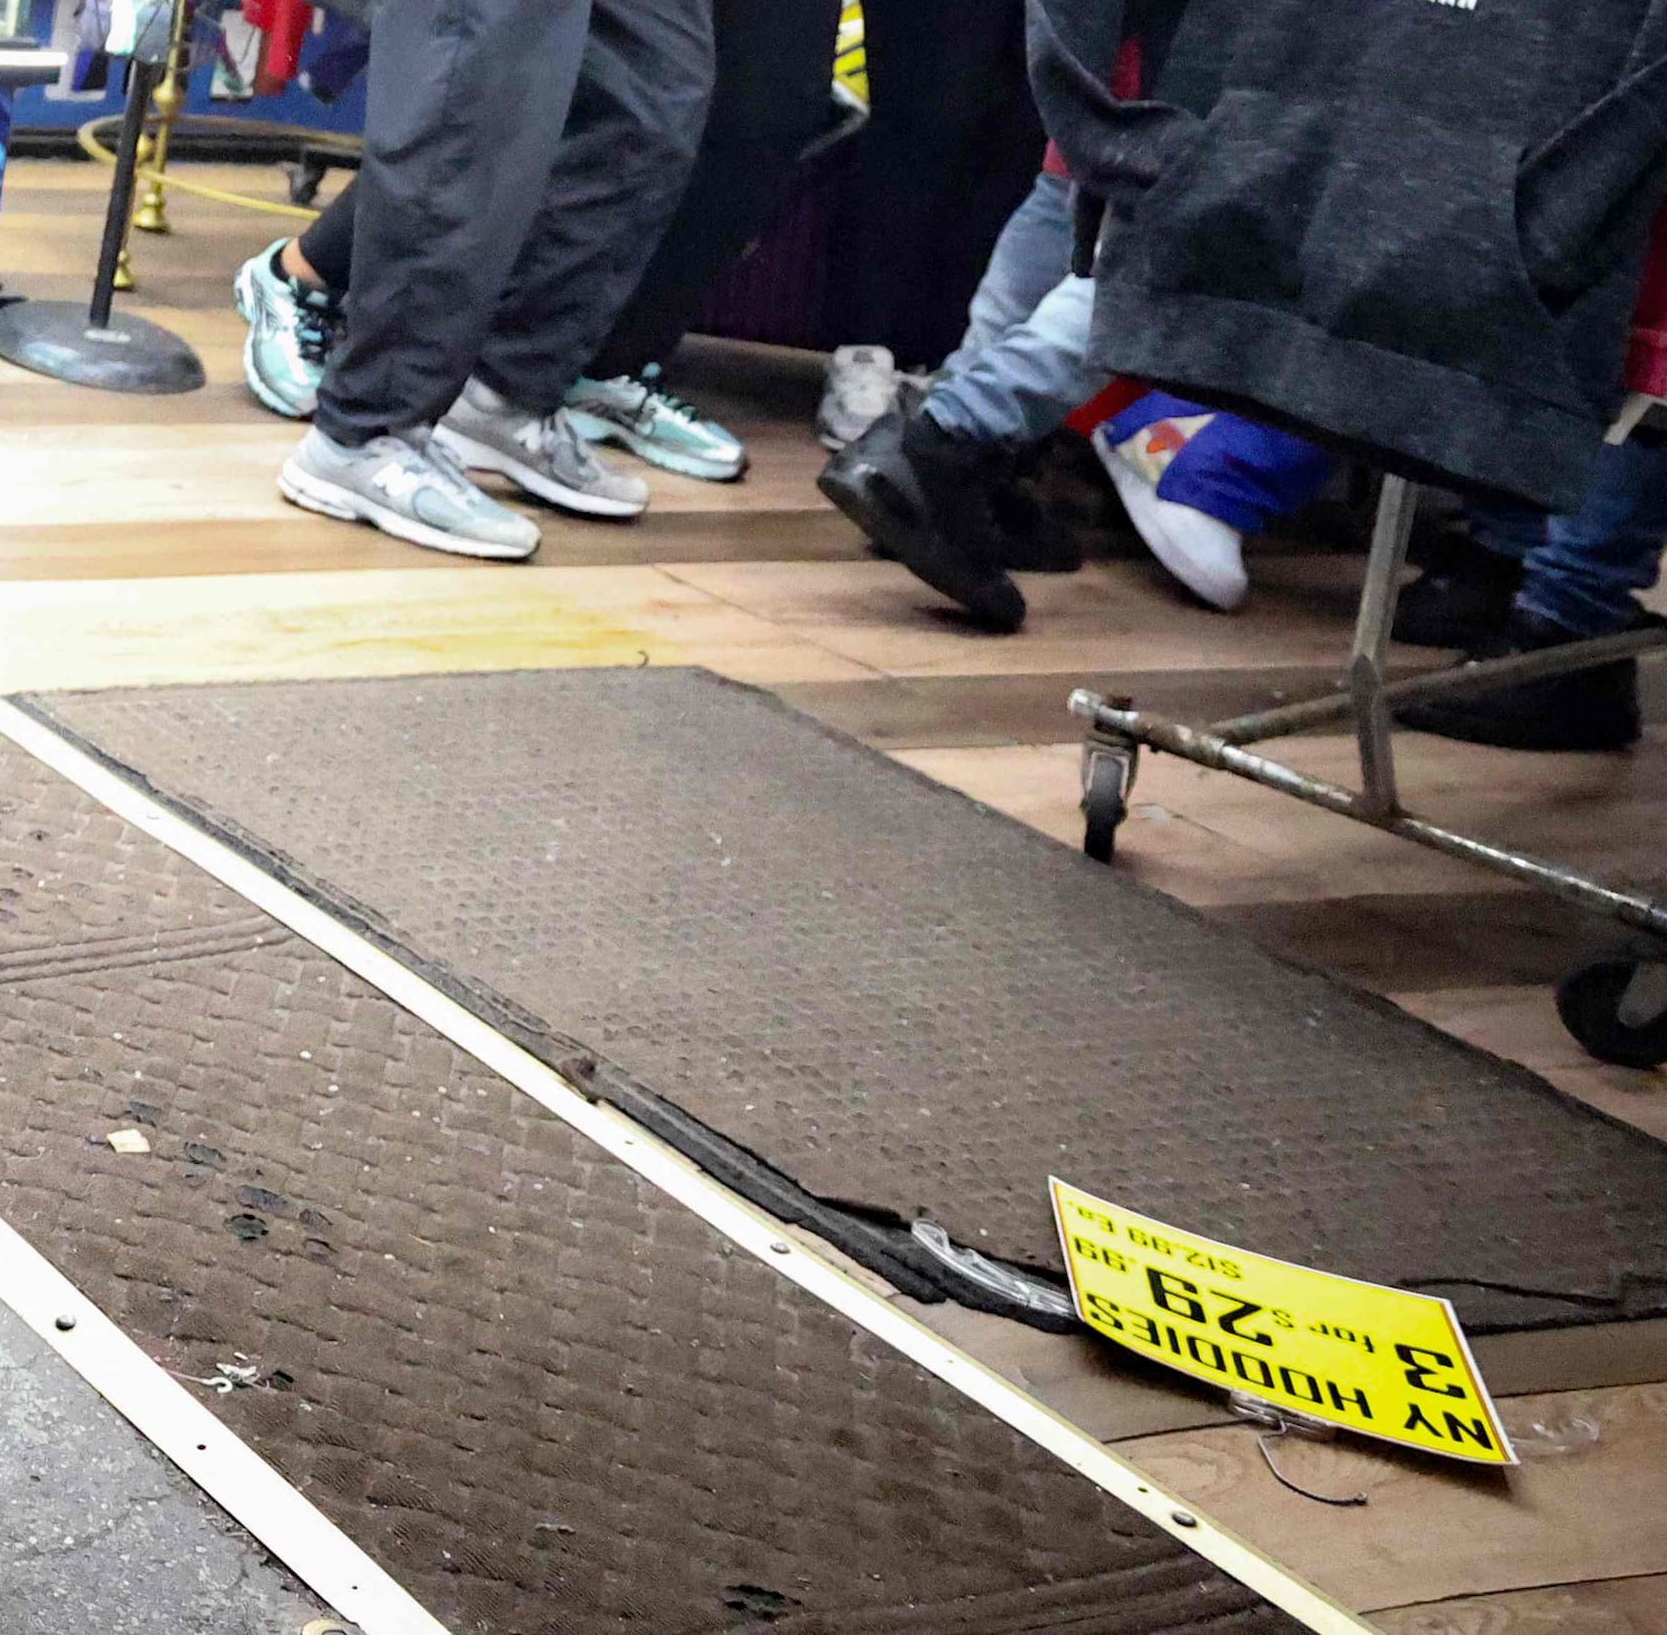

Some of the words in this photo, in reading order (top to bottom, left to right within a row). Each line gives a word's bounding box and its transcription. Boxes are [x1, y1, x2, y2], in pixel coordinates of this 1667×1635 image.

[1084, 1291, 1375, 1421] HOODIES
[1309, 1318, 1375, 1354] for
[1395, 1343, 1467, 1401] 3
[1403, 1403, 1495, 1451] NY
